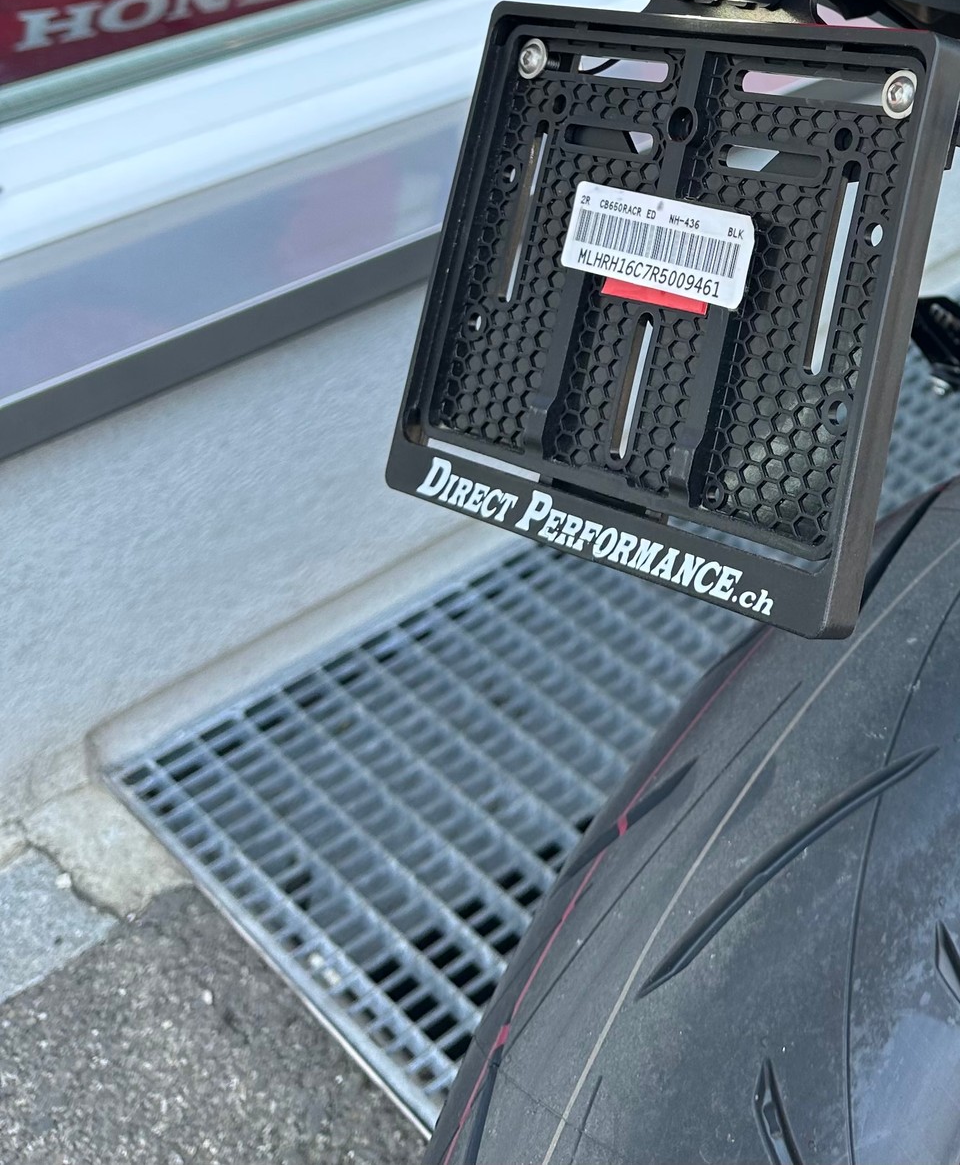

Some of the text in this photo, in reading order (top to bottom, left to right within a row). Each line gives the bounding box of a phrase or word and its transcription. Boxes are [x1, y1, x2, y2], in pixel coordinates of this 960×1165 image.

[580, 194, 745, 239] 2R CB650RACR ED NH-436 BLK
[577, 247, 721, 299] MLHRH16C7R5009461
[416, 456, 519, 523] DIRECT
